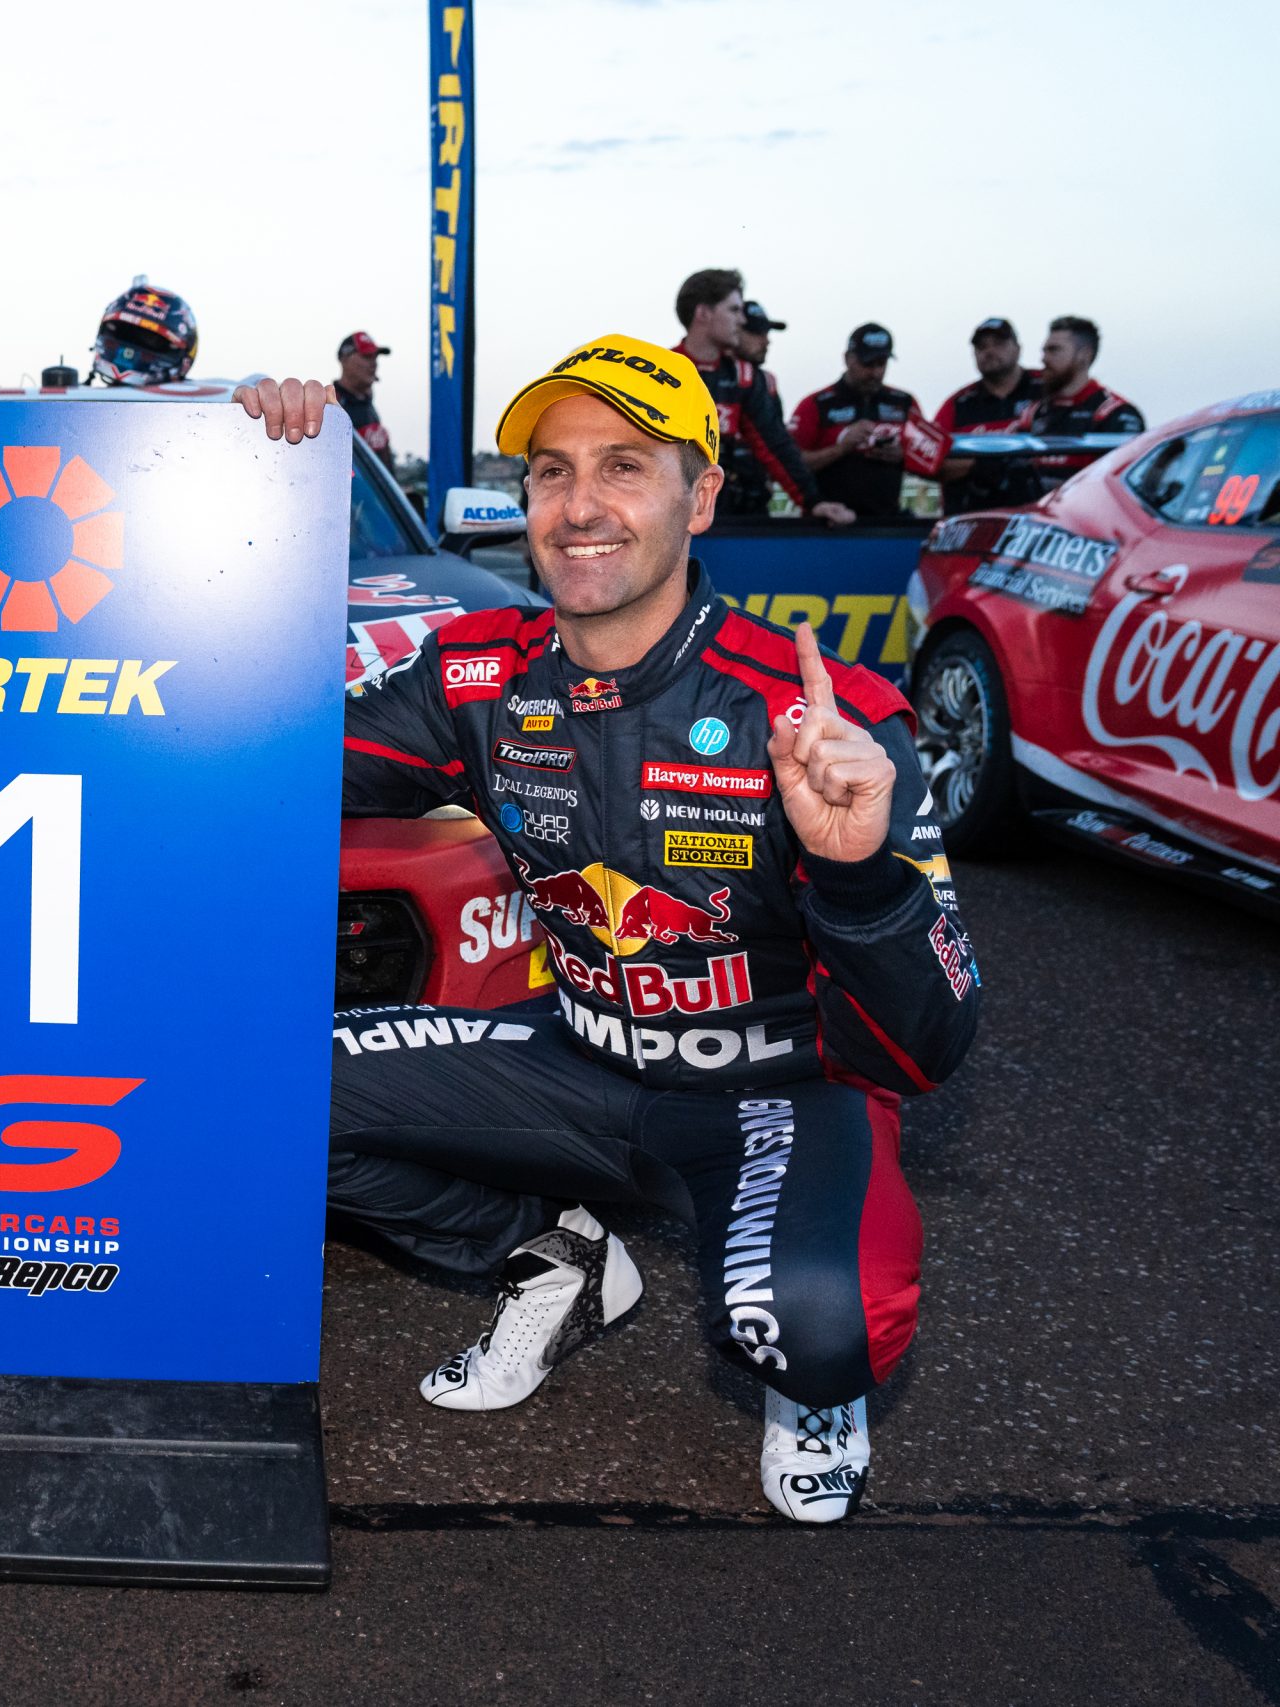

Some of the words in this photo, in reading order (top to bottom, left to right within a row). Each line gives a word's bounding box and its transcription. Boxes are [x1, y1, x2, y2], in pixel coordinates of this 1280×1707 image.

[1208, 474, 1260, 525] 99
[991, 513, 1120, 577] Partners
[446, 661, 501, 684] OMP
[573, 699, 598, 713] Red
[597, 695, 623, 710] Bull
[526, 719, 550, 729] AUTO
[695, 718, 724, 754] hp
[647, 768, 700, 788] Harvey
[702, 773, 765, 791] Norman
[524, 783, 579, 808] LEGENDS
[523, 809, 569, 830] QUAD
[665, 805, 700, 820] NEW
[524, 823, 571, 845] LOCK
[668, 834, 749, 850] NATIONAL
[671, 850, 746, 865] STORAGE
[621, 950, 753, 1018] Bull
[790, 1470, 860, 1494] OMP
